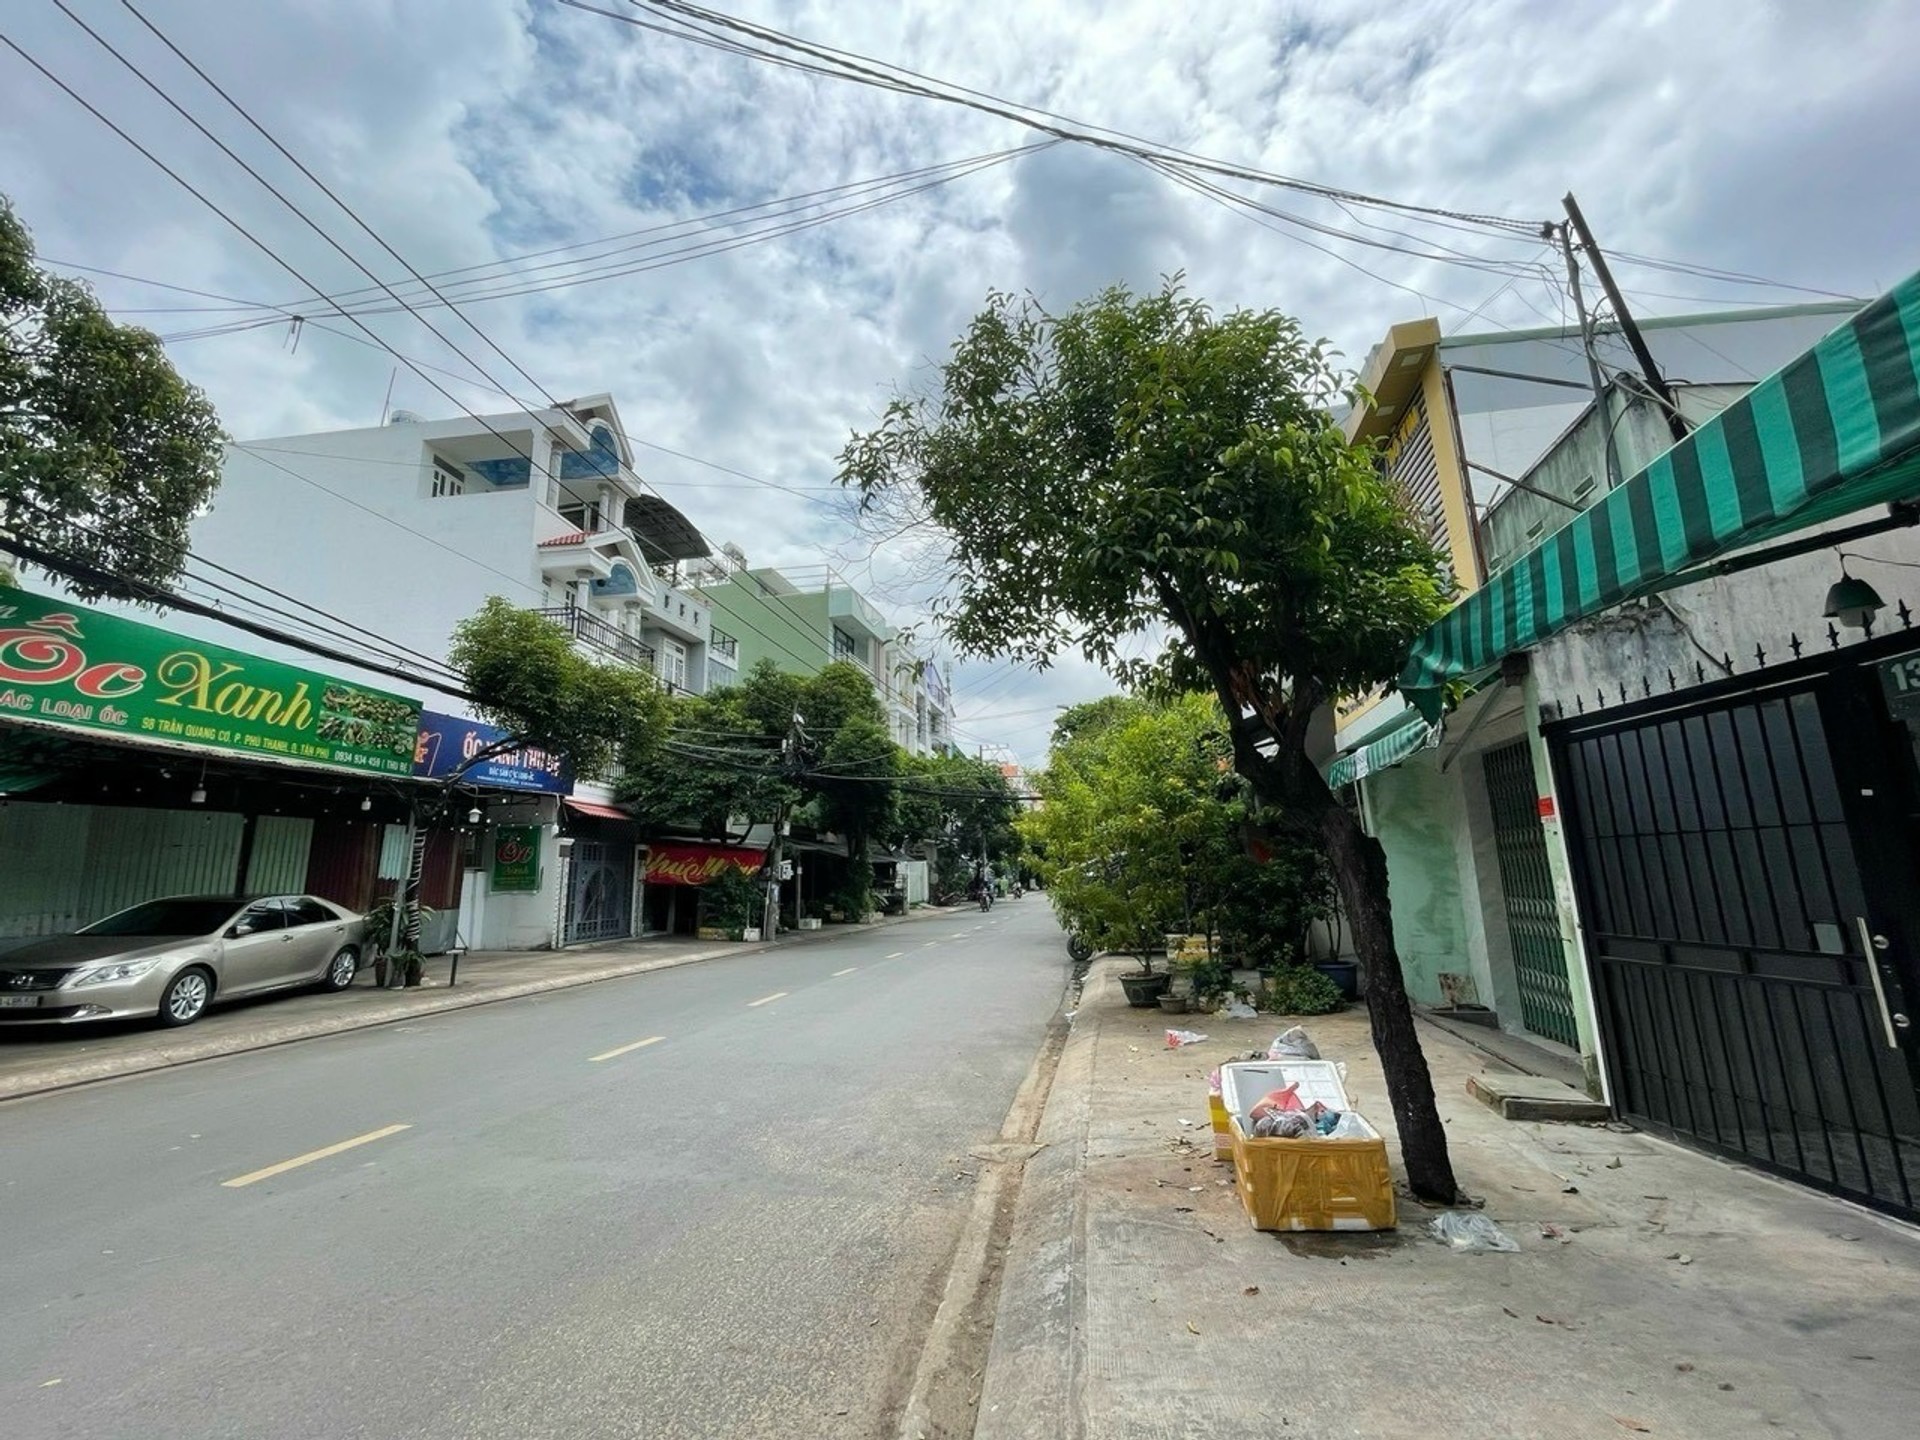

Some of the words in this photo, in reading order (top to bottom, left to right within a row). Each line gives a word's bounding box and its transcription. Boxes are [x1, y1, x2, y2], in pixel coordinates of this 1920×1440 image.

[156, 652, 313, 730] Xanh
[41, 698, 93, 720] LOẠI
[185, 724, 215, 740] QUANG
